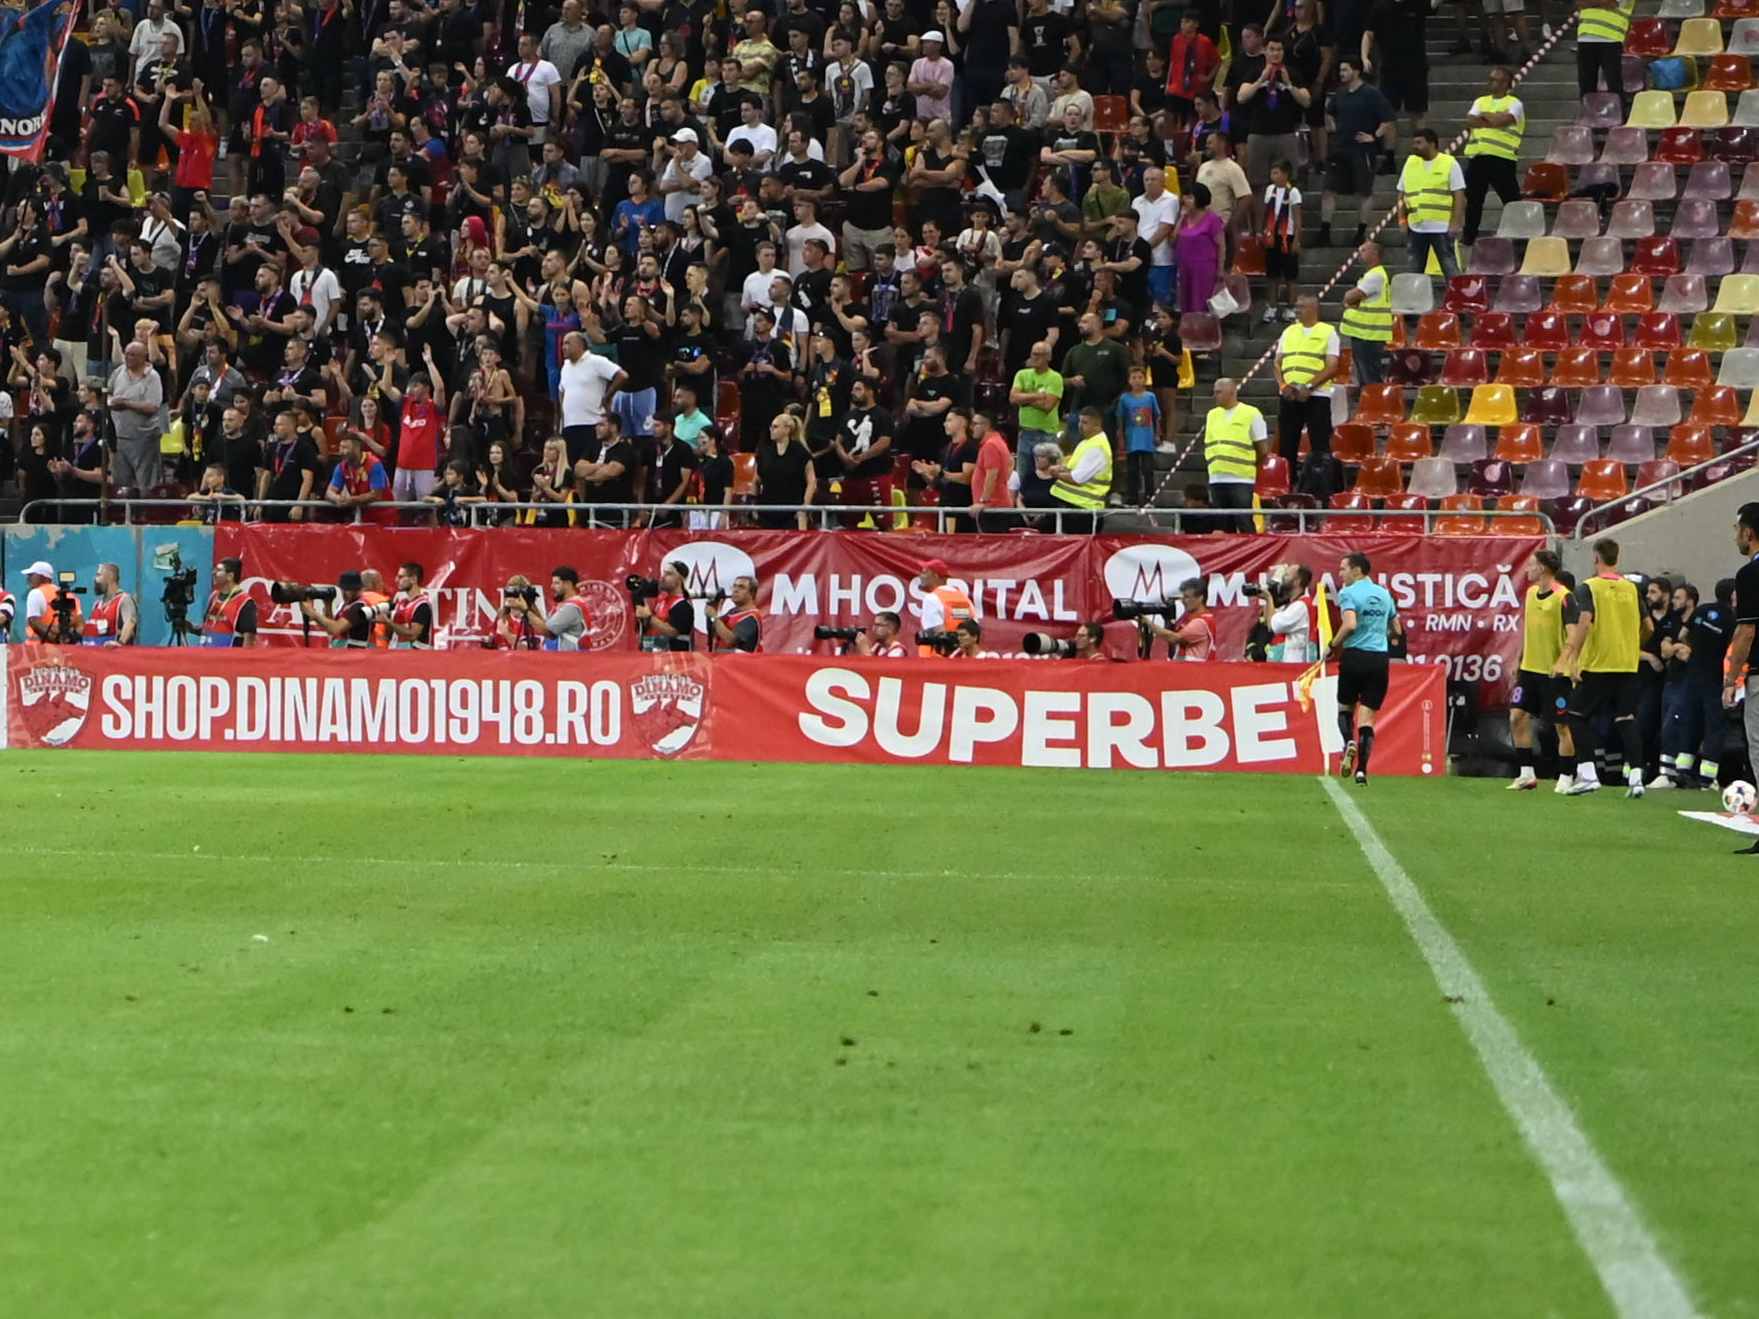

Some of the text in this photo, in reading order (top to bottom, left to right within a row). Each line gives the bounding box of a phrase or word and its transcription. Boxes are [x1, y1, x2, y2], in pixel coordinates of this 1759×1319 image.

[1425, 614, 1520, 633] RMN RX
[23, 671, 89, 690] DINAMO
[633, 679, 699, 698] DINAMO
[102, 674, 621, 746] SHOP.DINAMO1948.RO
